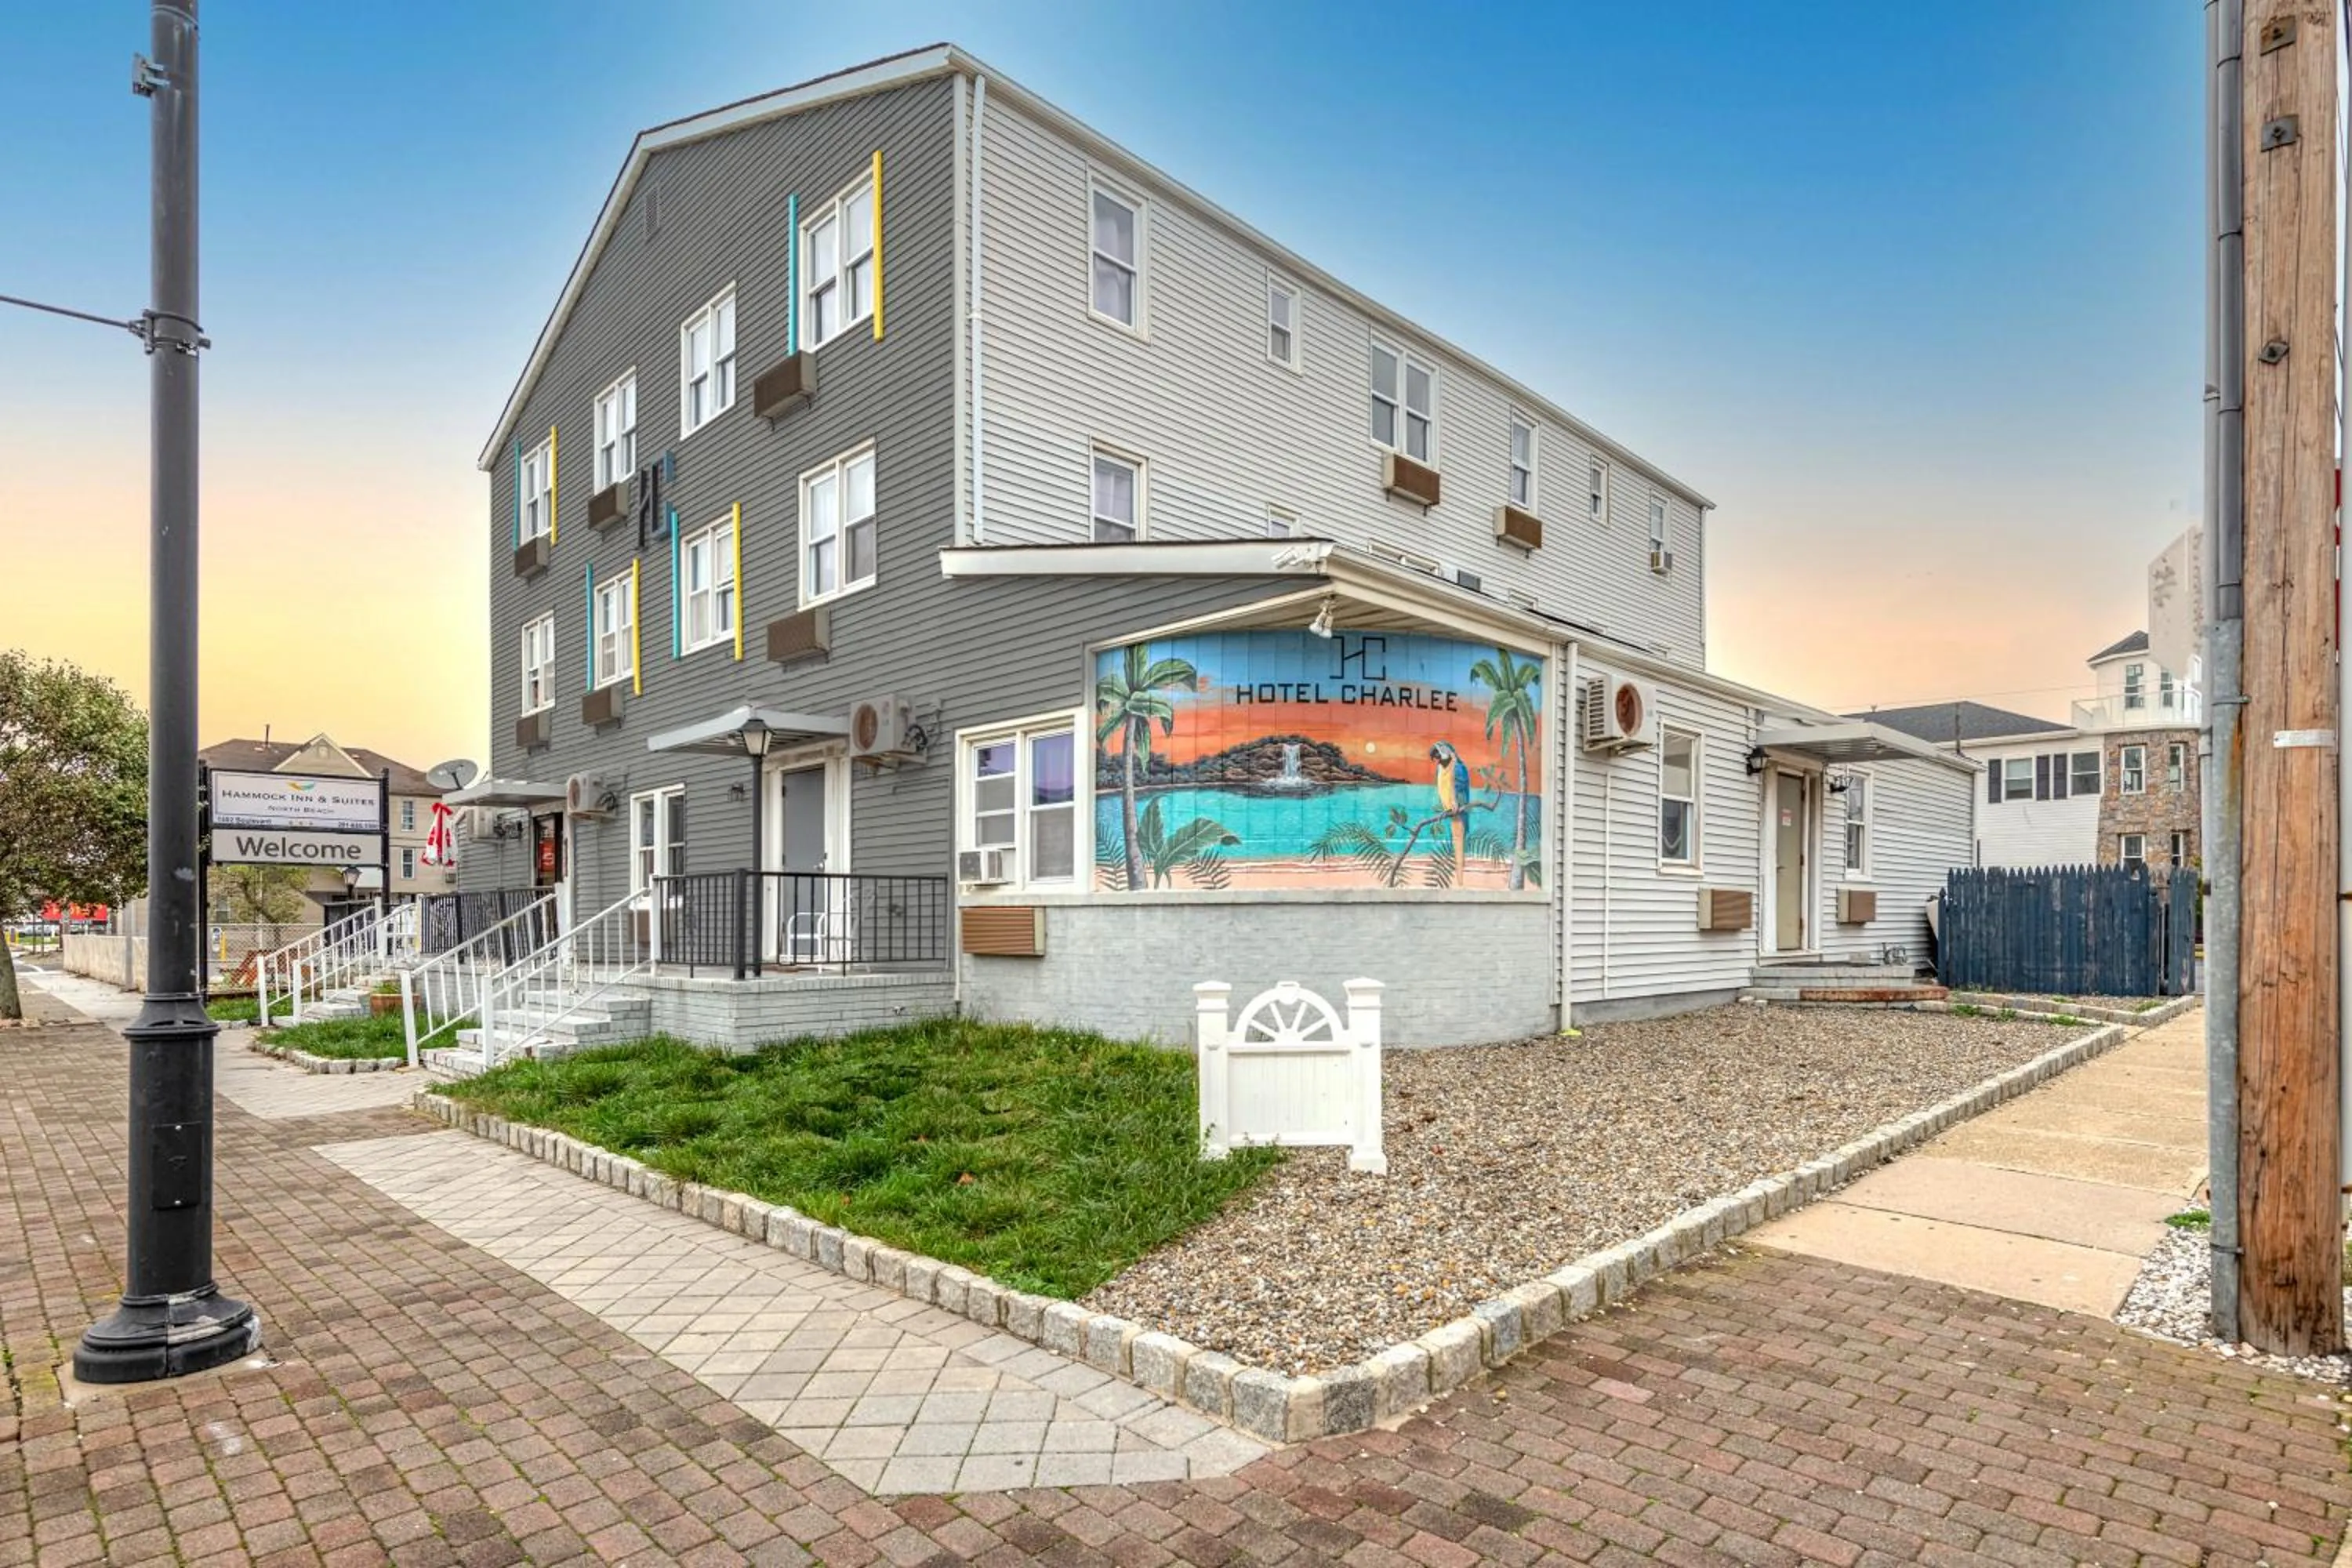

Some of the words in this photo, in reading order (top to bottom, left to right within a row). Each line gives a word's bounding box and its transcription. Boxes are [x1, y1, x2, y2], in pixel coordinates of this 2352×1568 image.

[1236, 683, 1329, 704] HOTEL
[1341, 684, 1458, 713] CHARLEE
[222, 789, 286, 801] HAMMOCK
[318, 795, 326, 804] &
[332, 795, 375, 806] SUITES
[236, 835, 361, 860] Welcome
